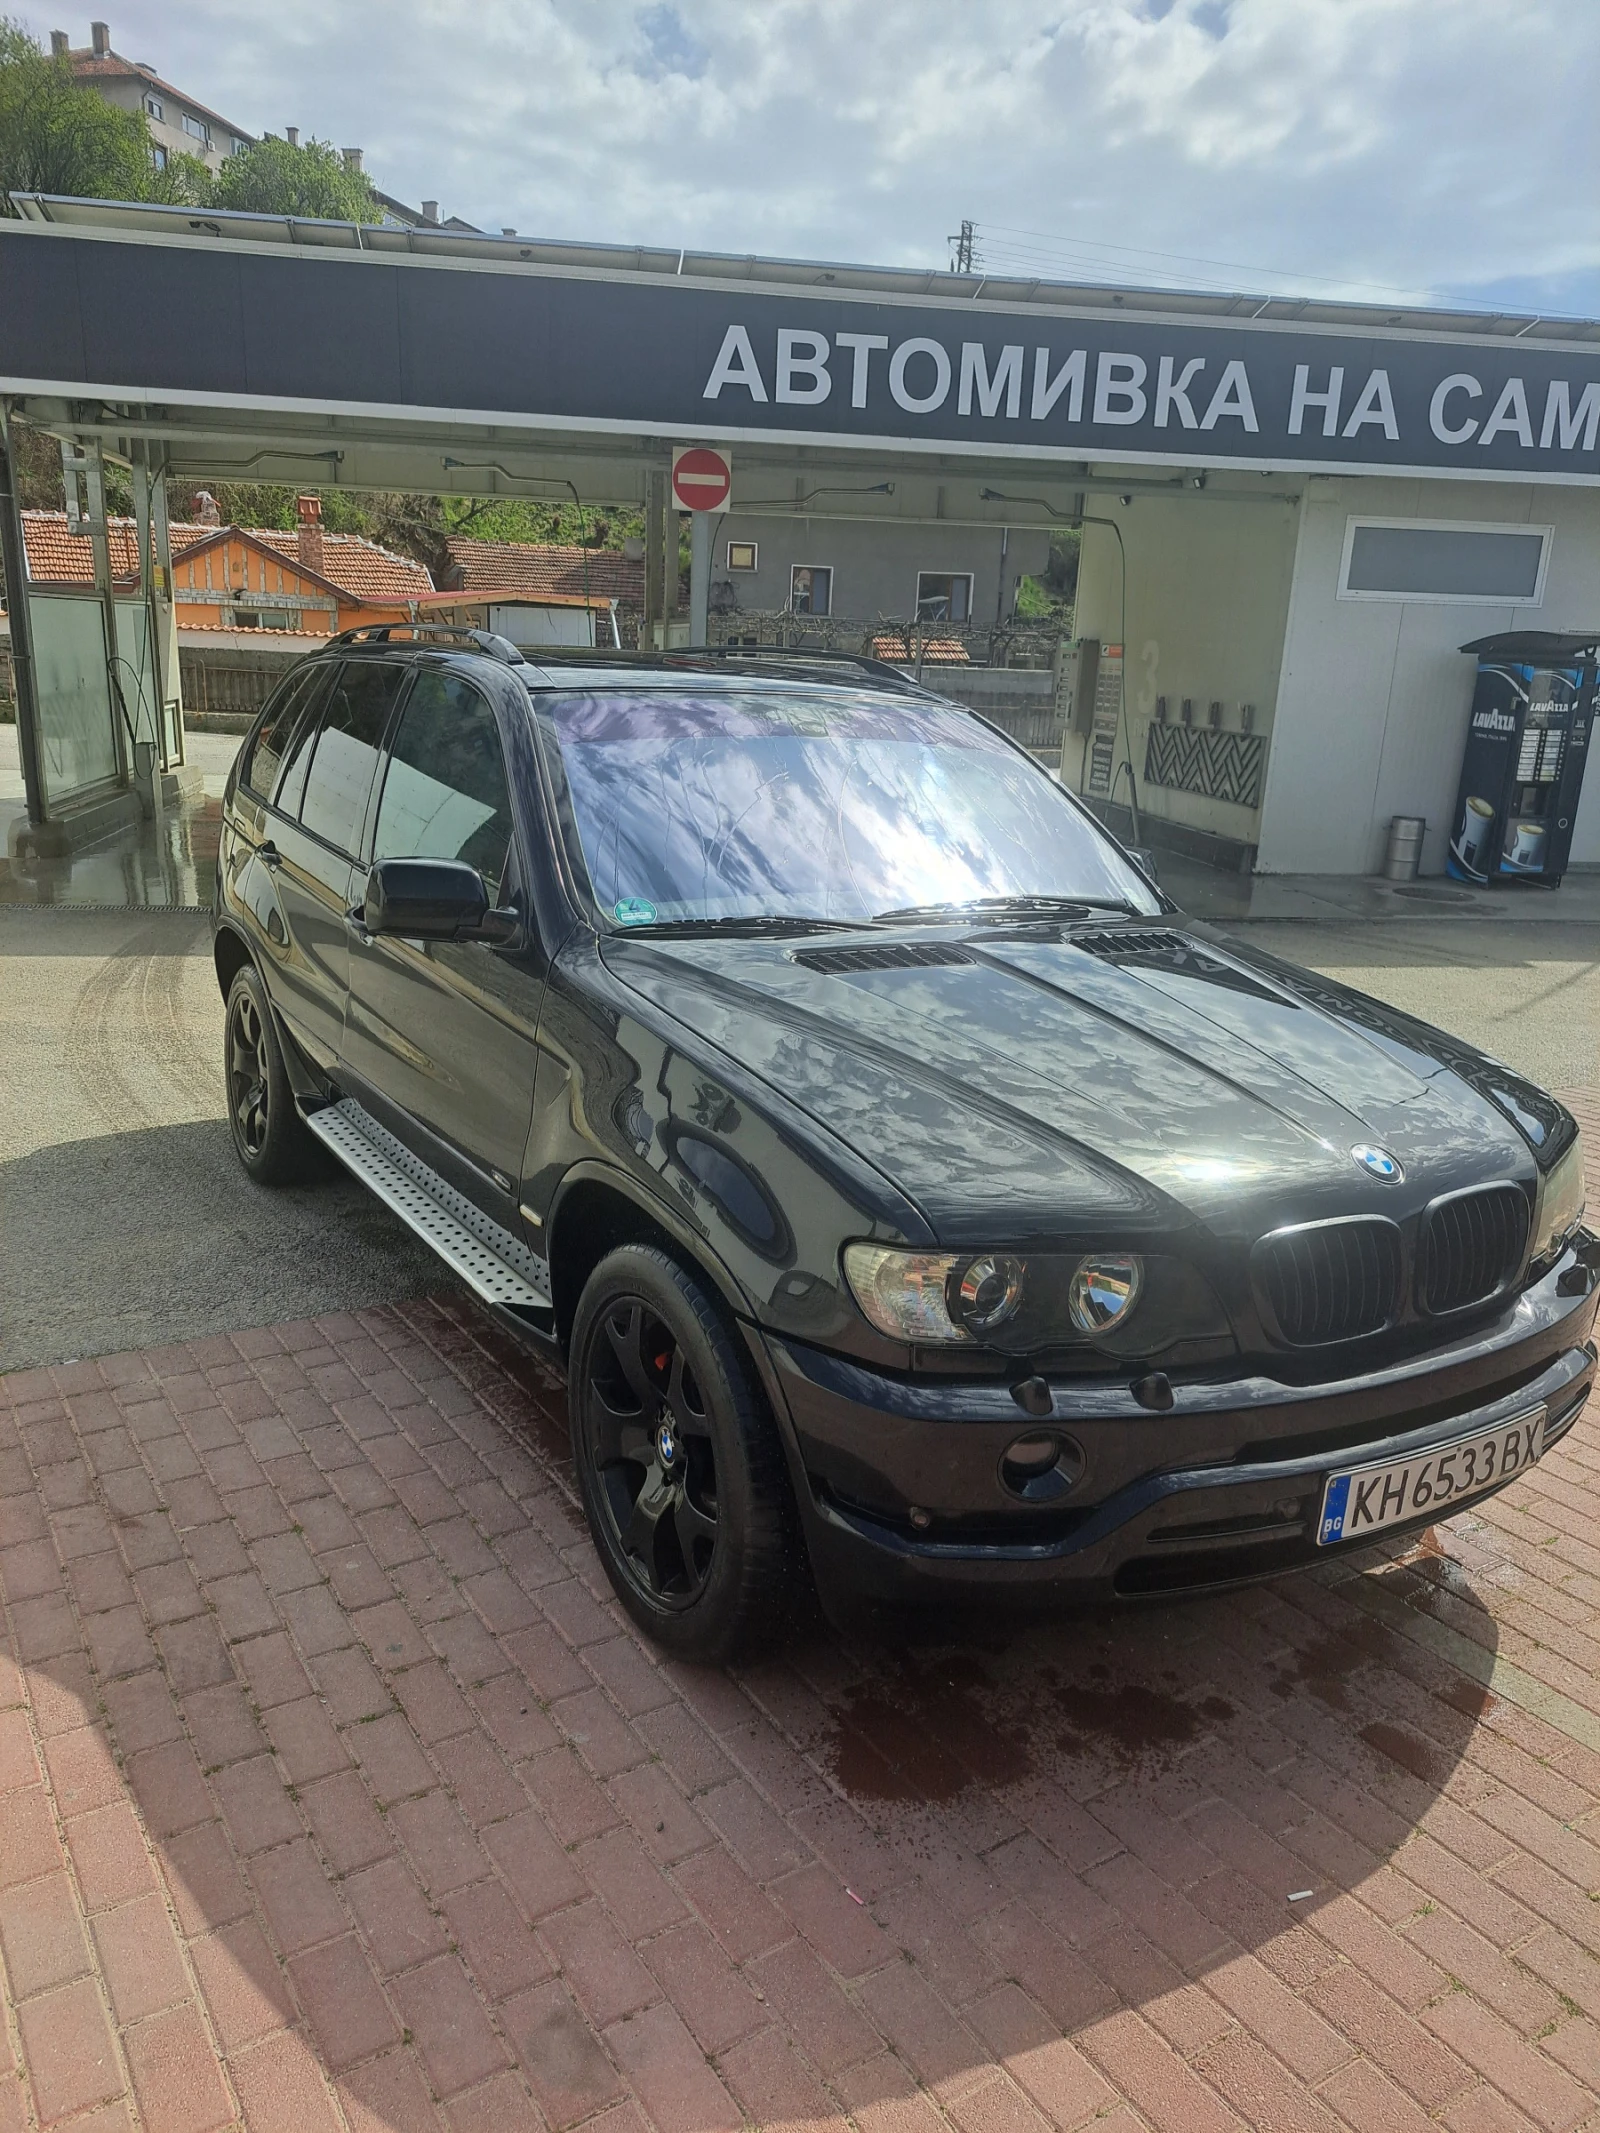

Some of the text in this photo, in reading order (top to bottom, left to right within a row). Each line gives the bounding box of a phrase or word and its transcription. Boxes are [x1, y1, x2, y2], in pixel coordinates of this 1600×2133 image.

[702, 325, 1600, 451] АВТОМИВКА НА САМ
[1530, 700, 1569, 712] LAVAZZA
[1472, 708, 1516, 732] LAVAZZA
[1324, 1518, 1342, 1533] BG
